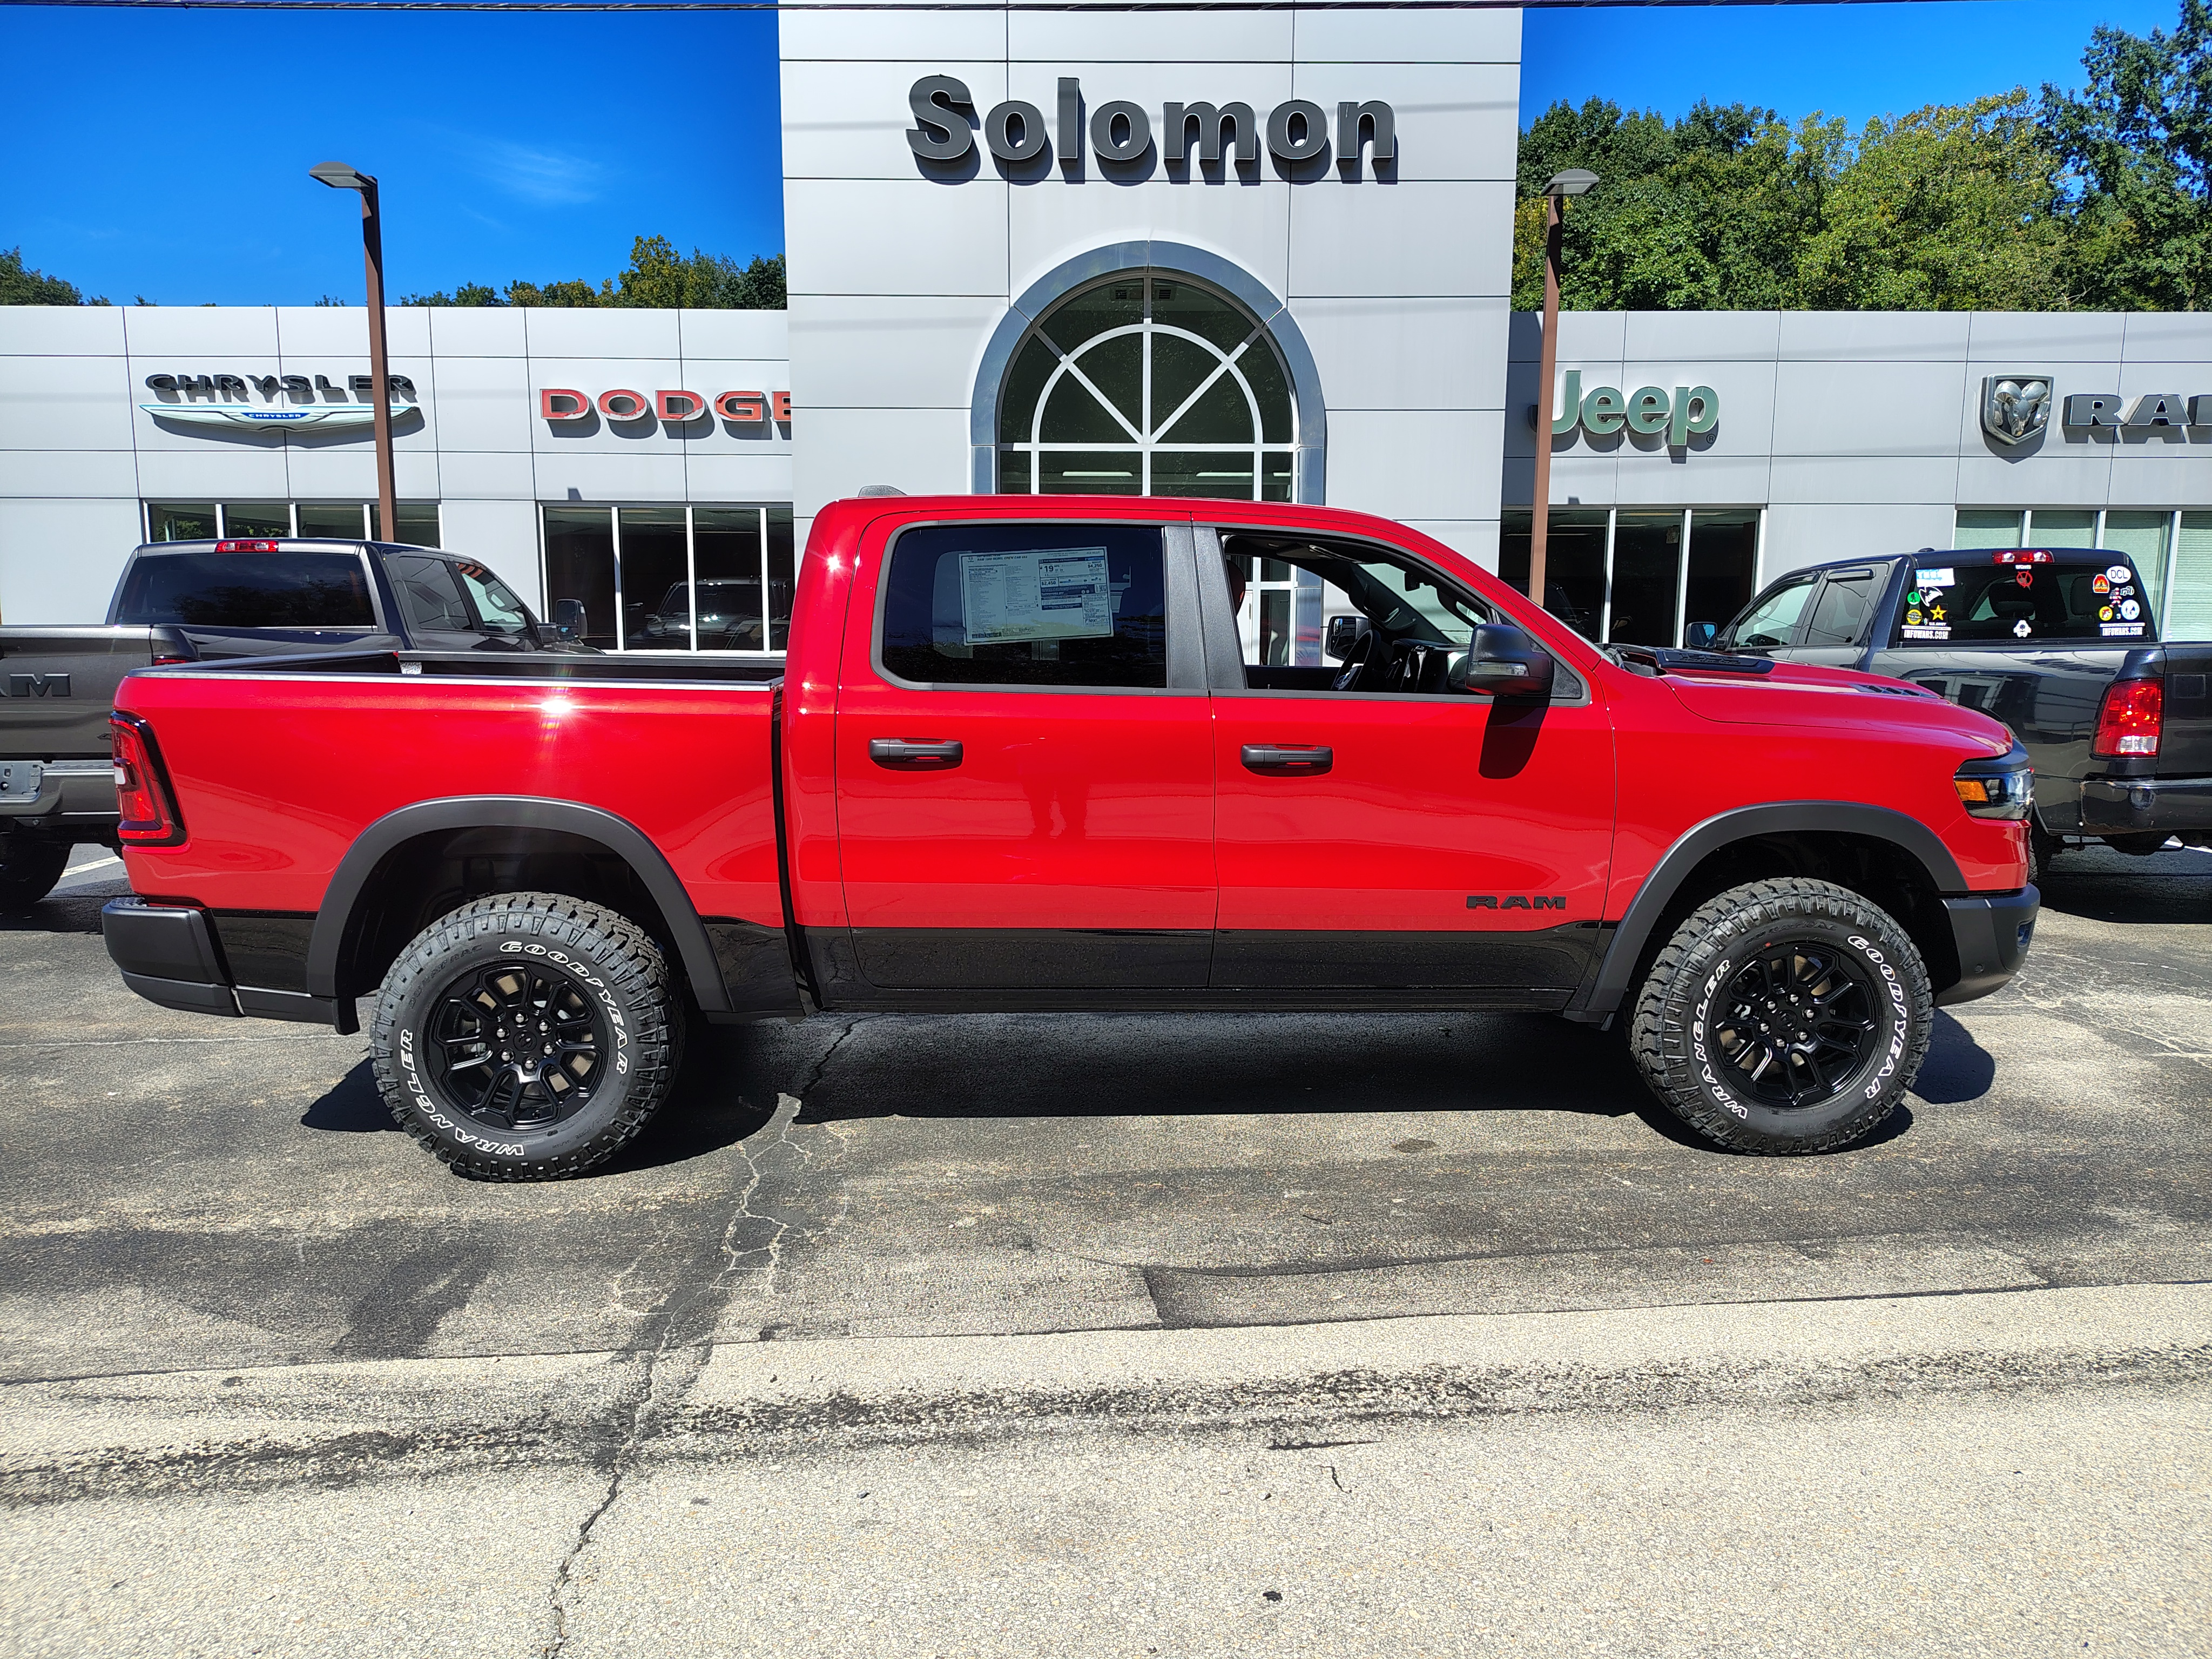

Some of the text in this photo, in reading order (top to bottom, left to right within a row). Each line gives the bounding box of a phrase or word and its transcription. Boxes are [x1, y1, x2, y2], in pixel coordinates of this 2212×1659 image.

[905, 75, 1395, 161] Solomon
[145, 373, 416, 393] CHRYSLER
[1552, 370, 1719, 446] Jeep
[2063, 394, 2212, 426] RA
[2110, 569, 2128, 579] DCL
[1904, 629, 1948, 639] INFOWARS.COM
[2102, 626, 2143, 636] INFOWARS.COM
[0, 673, 71, 698] M
[1466, 895, 1567, 910] RAM
[500, 941, 629, 1075] GOODYEAR
[1847, 935, 1906, 1100] GOODYEAR
[1692, 959, 1749, 1120] WRANGLER
[400, 1028, 524, 1156] WRANGLER
